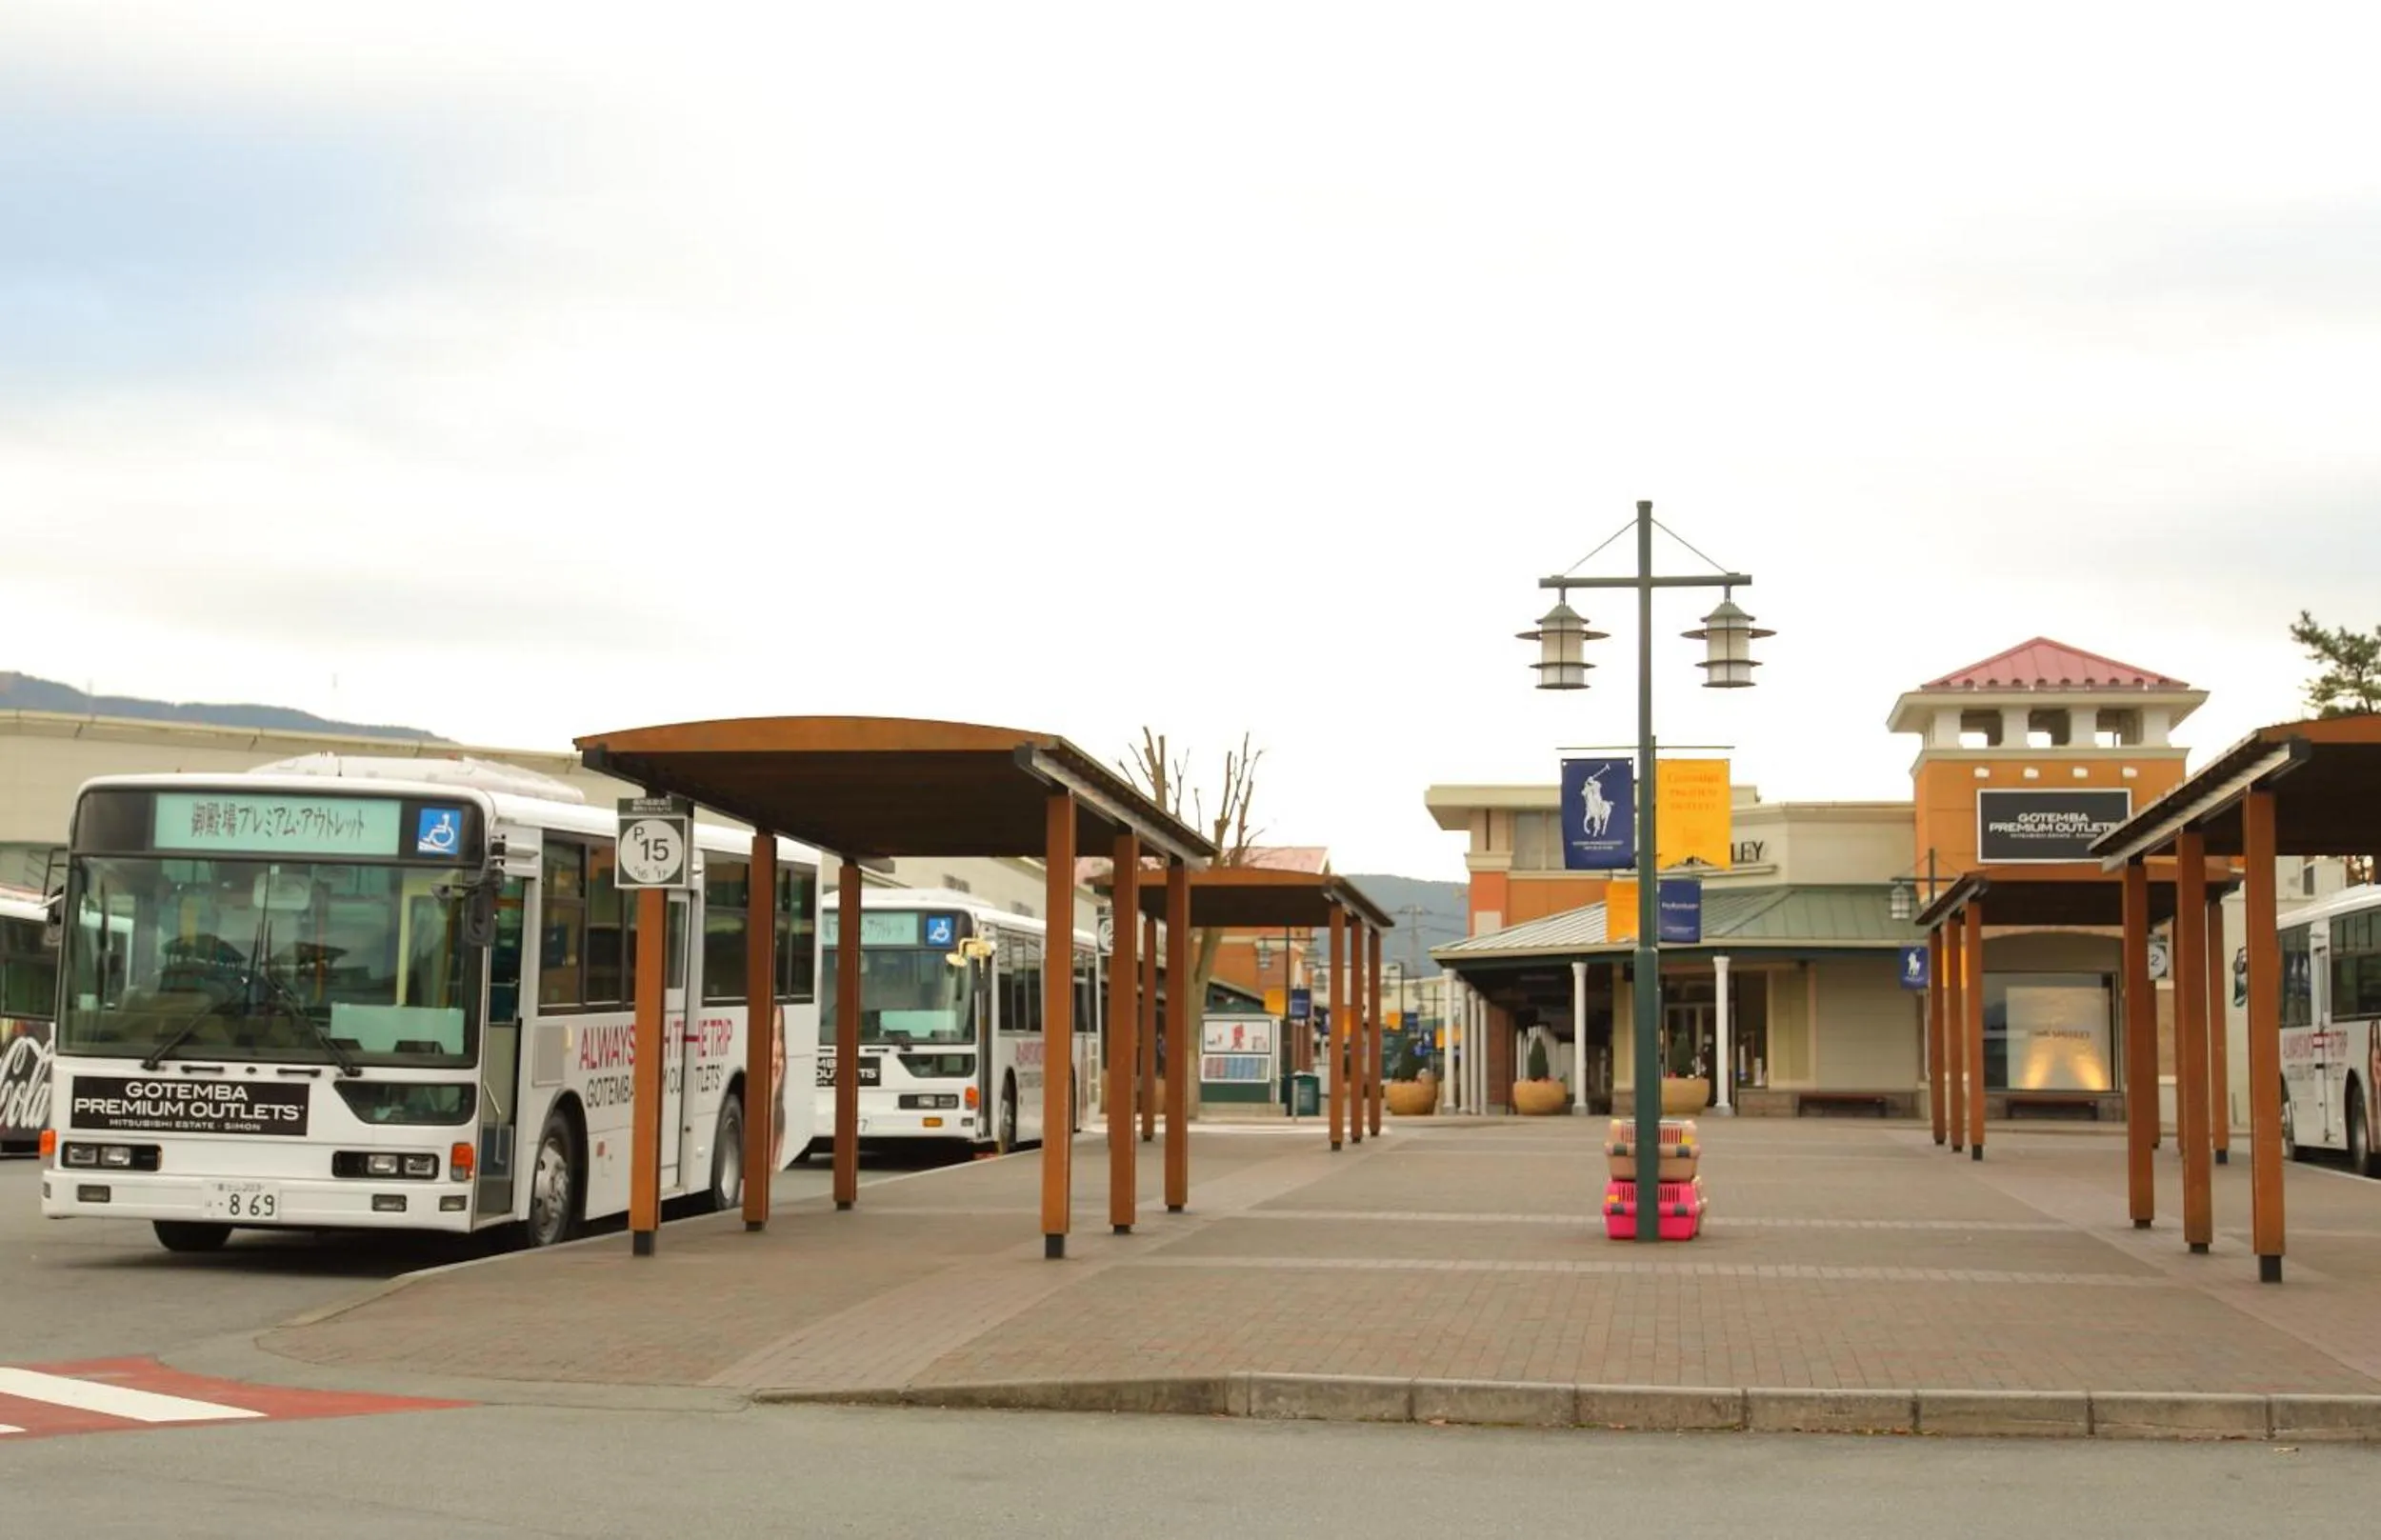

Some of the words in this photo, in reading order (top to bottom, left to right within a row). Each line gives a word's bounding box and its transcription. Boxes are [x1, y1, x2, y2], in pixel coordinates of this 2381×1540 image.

[1989, 822, 2053, 833] PREMIUM
[2017, 812, 2090, 824] GOTEMBA
[640, 838, 670, 862] 15
[579, 1025, 635, 1070] ALWAYS
[125, 1082, 249, 1101] GOTEMBA
[74, 1098, 185, 1117] PREMIUM
[190, 1102, 300, 1121] OUTLETS
[109, 1118, 173, 1129] MITSUBISHI
[175, 1120, 215, 1130] ESTATE
[225, 1122, 261, 1131] SIMON
